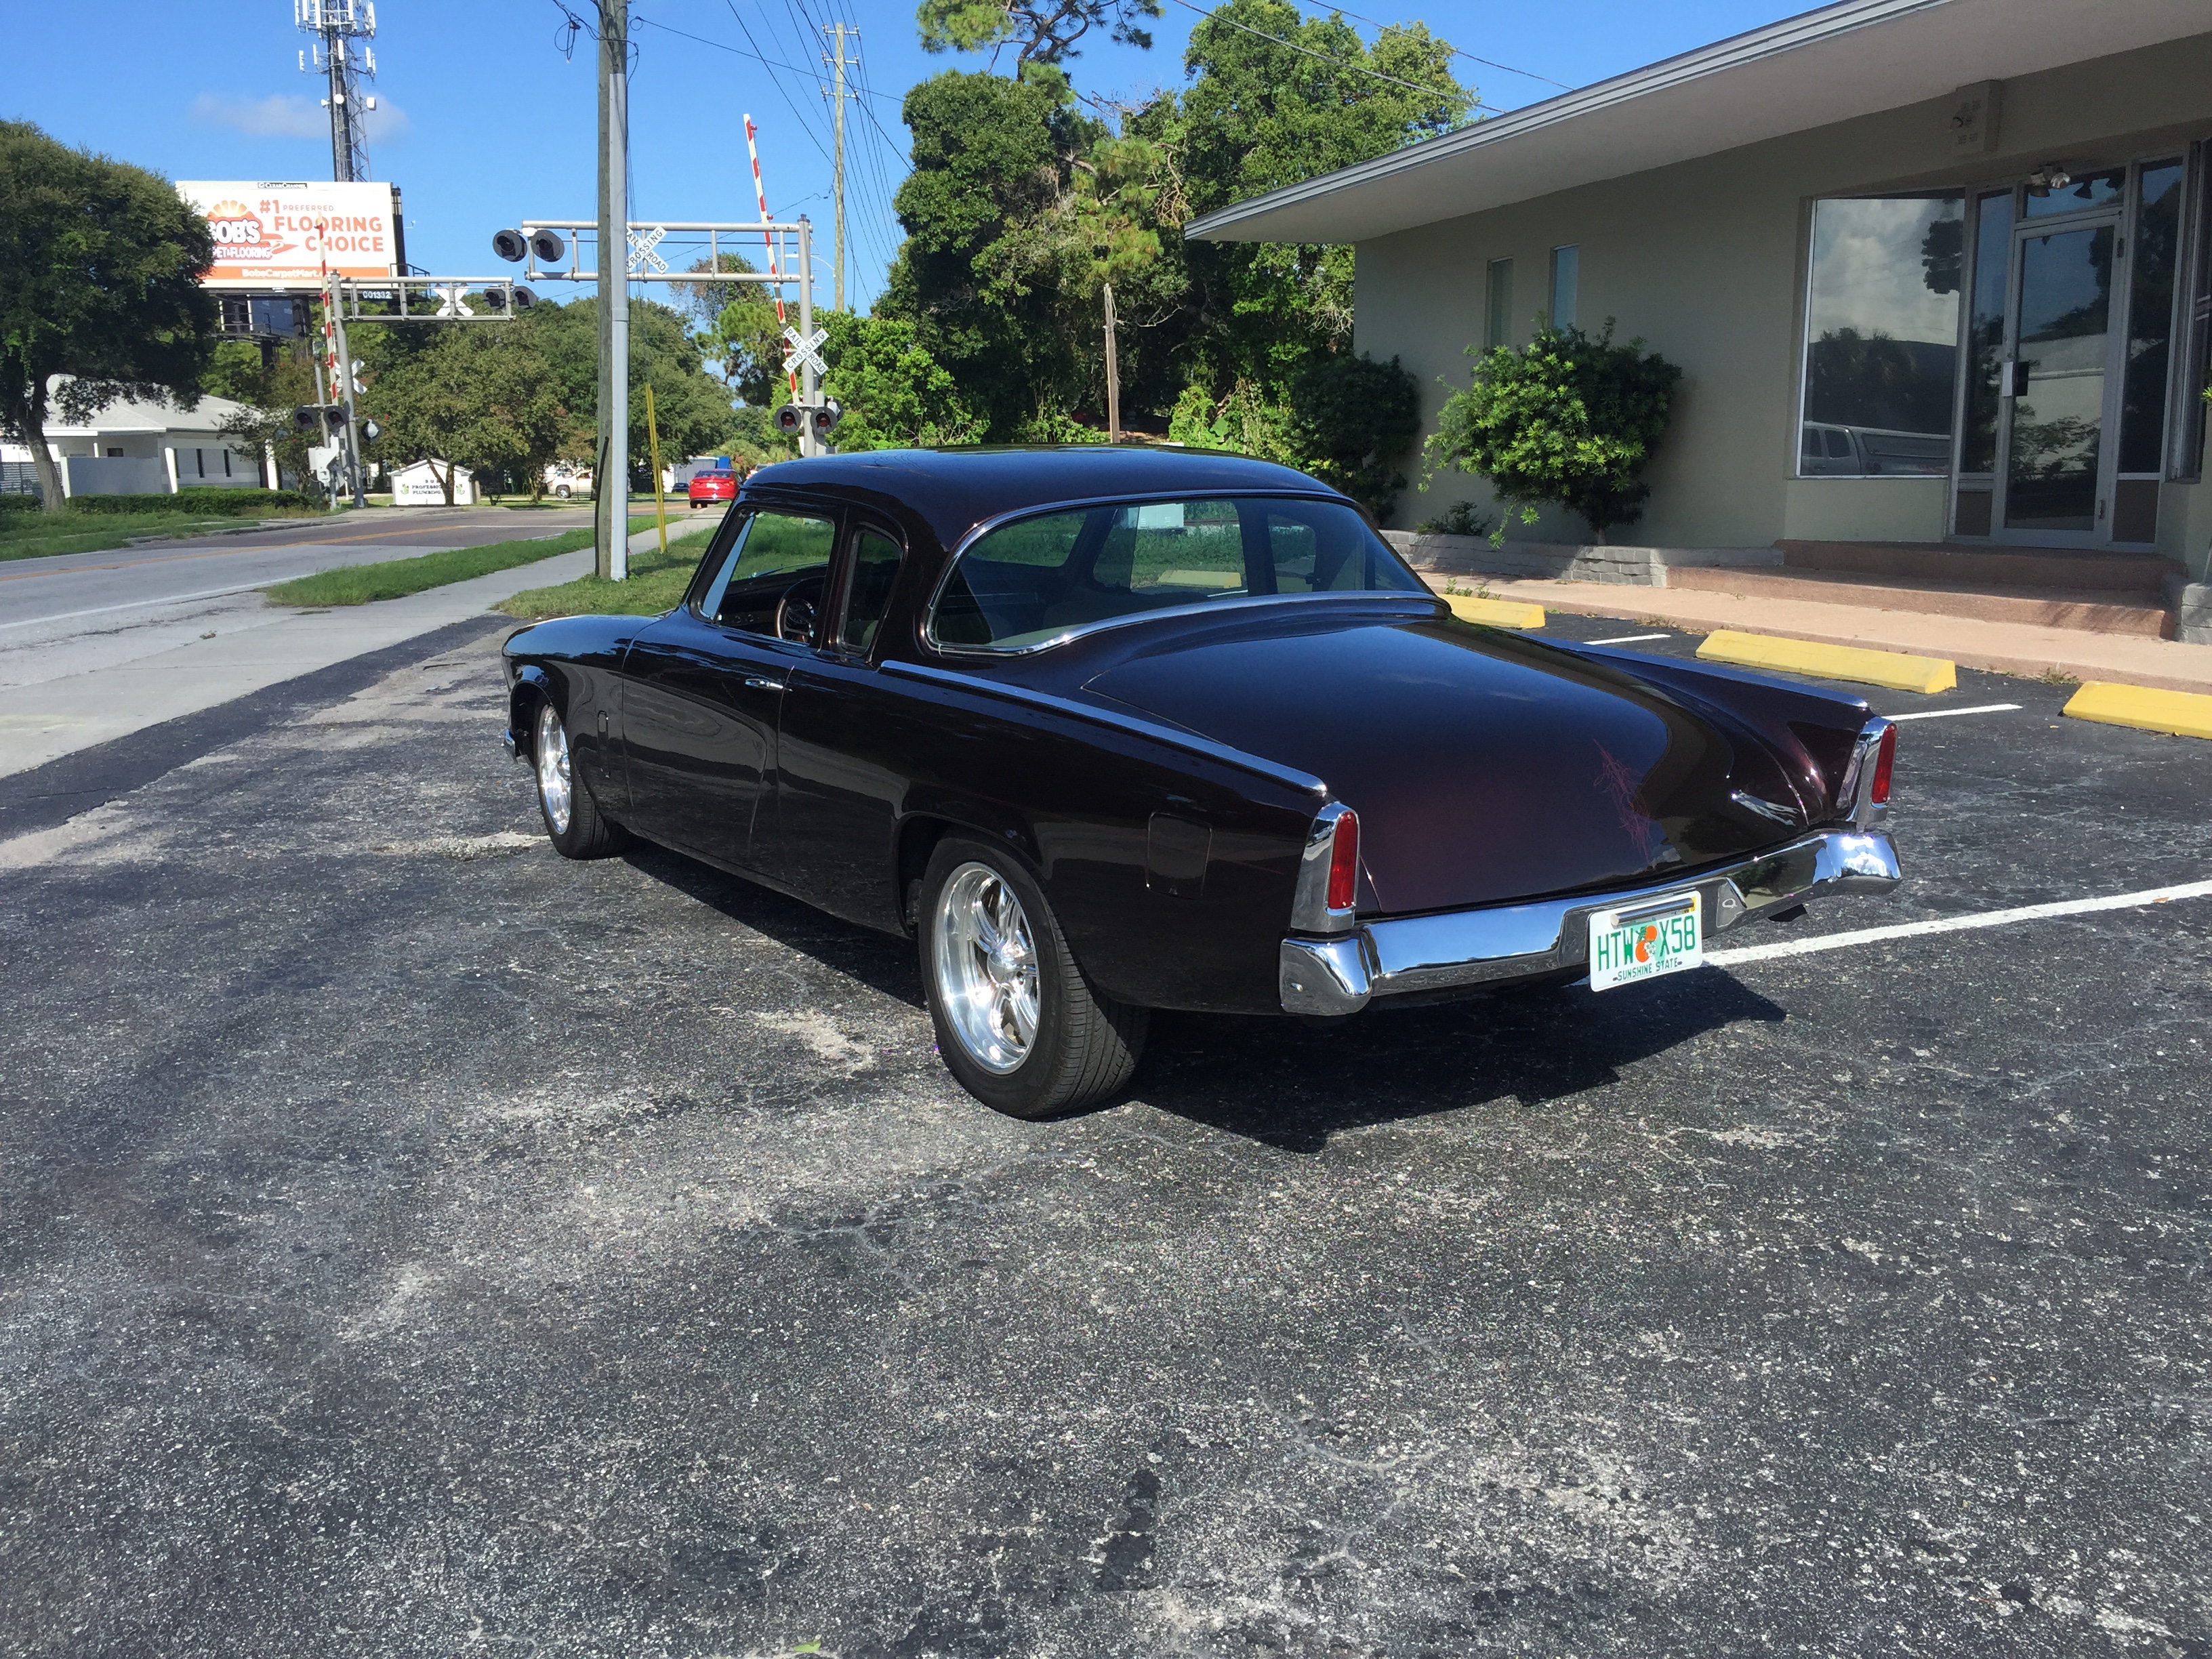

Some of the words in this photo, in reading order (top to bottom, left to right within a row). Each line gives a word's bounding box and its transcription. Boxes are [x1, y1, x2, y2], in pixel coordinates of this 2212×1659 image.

[260, 199, 280, 213] #1
[274, 216, 382, 232] FLOORING
[305, 236, 384, 252] CHOICE
[626, 230, 639, 247] AIL
[646, 251, 666, 271] ROAD
[786, 328, 802, 348] RAIL
[808, 353, 826, 373] ROAD
[787, 332, 825, 369] CROSSING
[1597, 927, 1634, 972] HTW
[1659, 914, 1696, 958] X58
[1617, 962, 1653, 982] SUNSHINE
[1655, 957, 1679, 972] STATE
